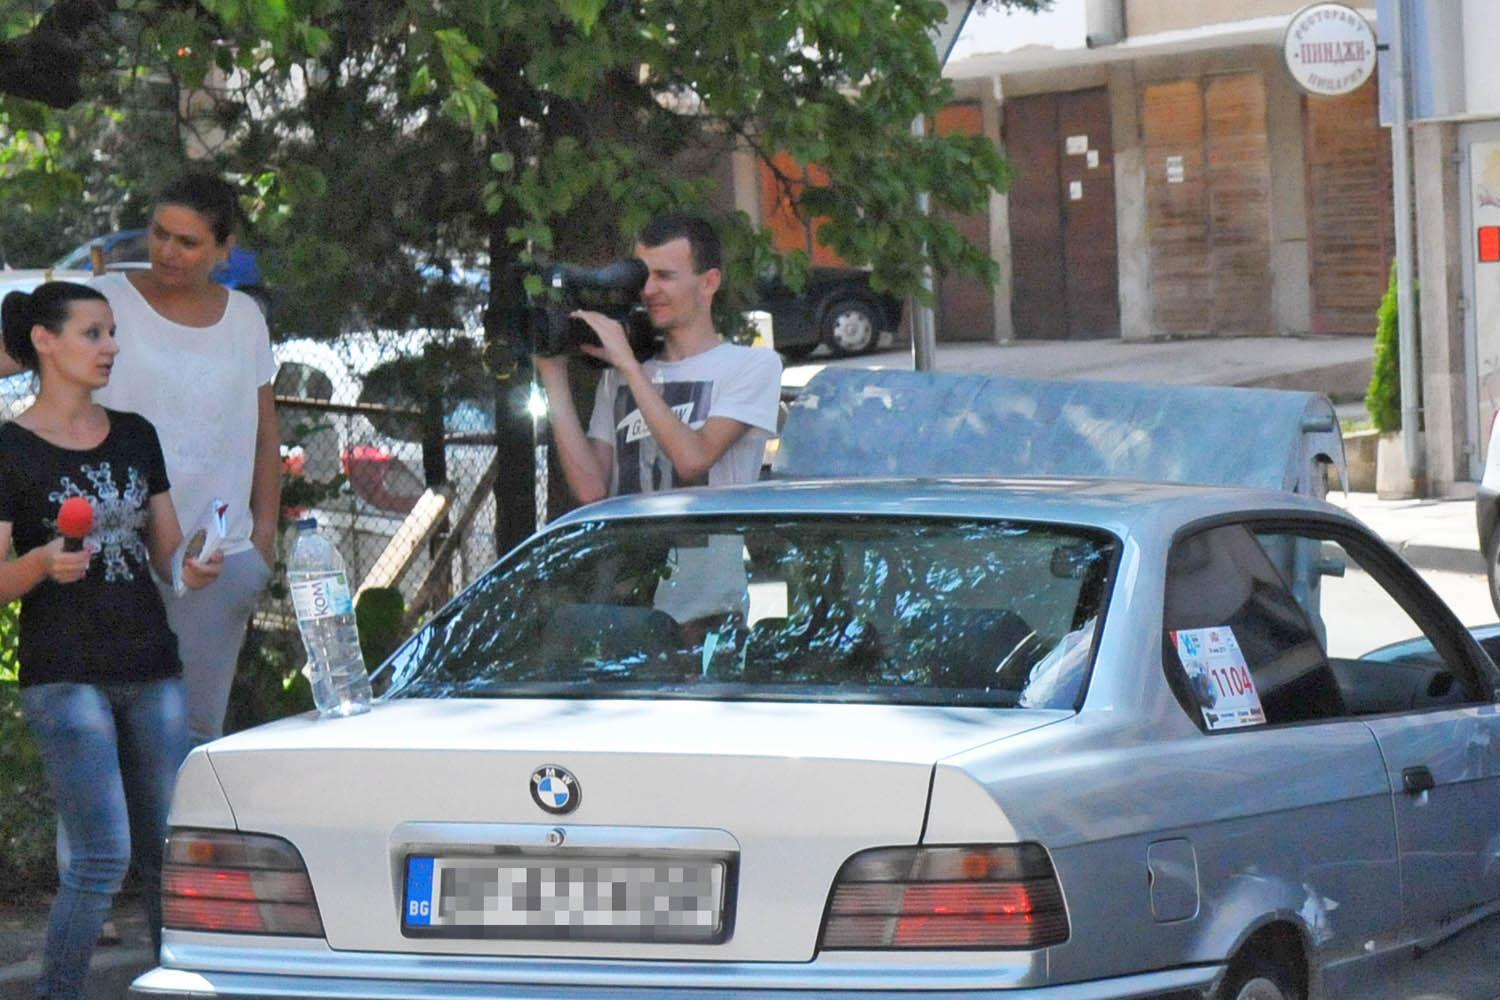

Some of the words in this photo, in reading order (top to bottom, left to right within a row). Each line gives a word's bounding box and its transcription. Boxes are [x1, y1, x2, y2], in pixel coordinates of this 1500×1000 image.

[1211, 666, 1254, 698] 1104
[533, 767, 575, 785] BMW
[409, 901, 430, 917] BG
